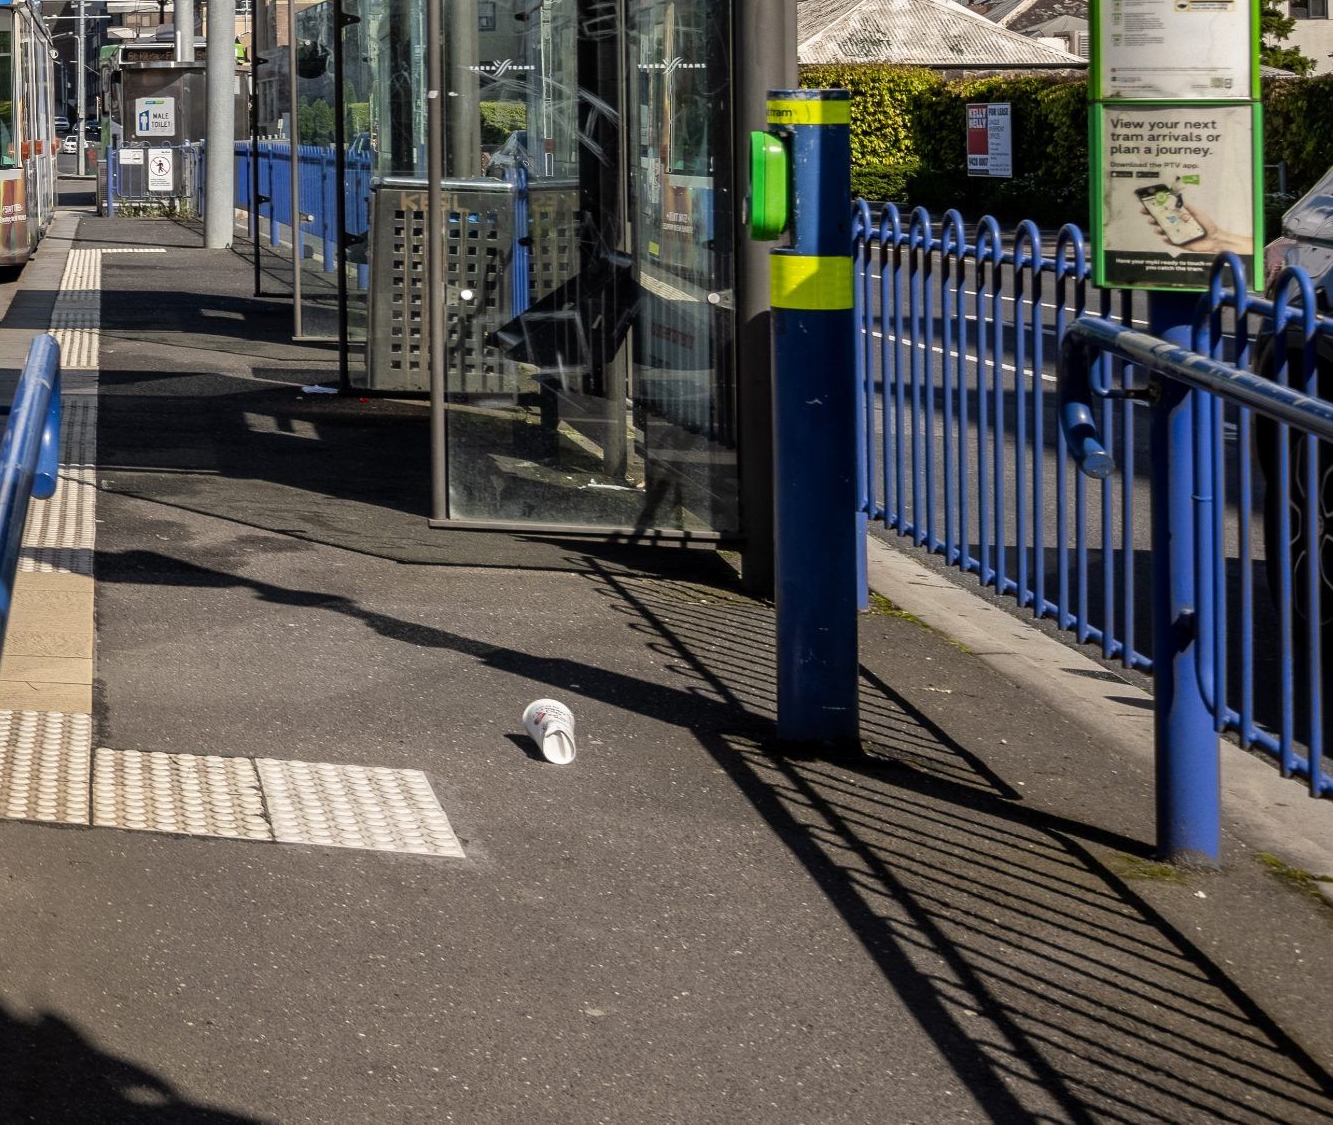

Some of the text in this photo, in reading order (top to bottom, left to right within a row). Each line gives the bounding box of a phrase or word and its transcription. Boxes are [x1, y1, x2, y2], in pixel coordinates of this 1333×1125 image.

[989, 108, 997, 116] FOR
[1110, 118, 1217, 131] View your next
[1111, 132, 1144, 141] tram
[1147, 132, 1202, 142] arrivals
[1110, 144, 1140, 156] plan
[1155, 144, 1213, 157] journey.
